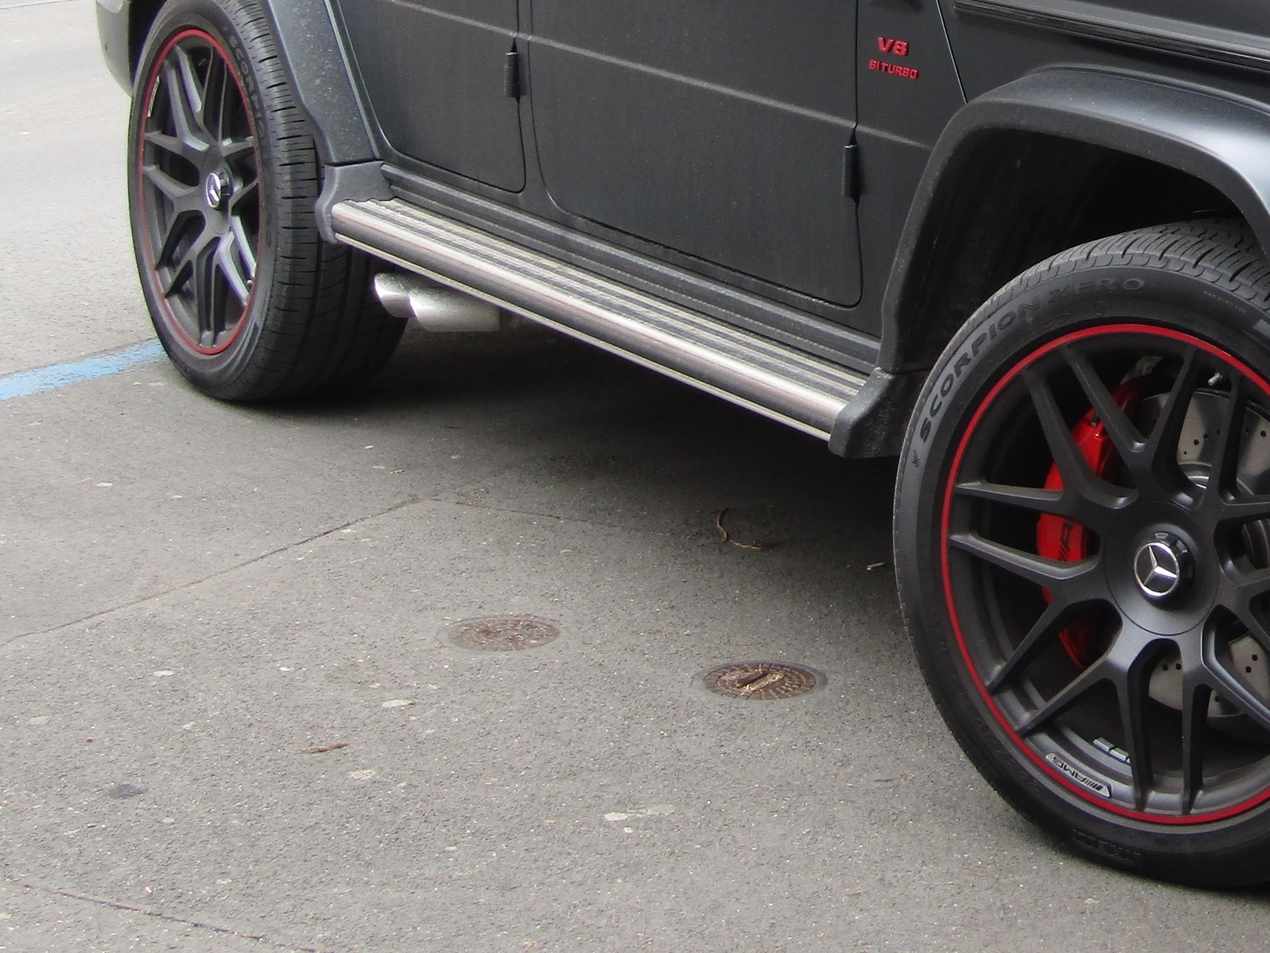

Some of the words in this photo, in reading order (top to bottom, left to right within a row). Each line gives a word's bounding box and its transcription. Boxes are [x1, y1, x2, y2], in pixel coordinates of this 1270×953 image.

[877, 36, 909, 56] V8
[868, 59, 919, 79] BITURBO
[920, 295, 1040, 443] SCORPION
[1047, 277, 1145, 304] ZERO
